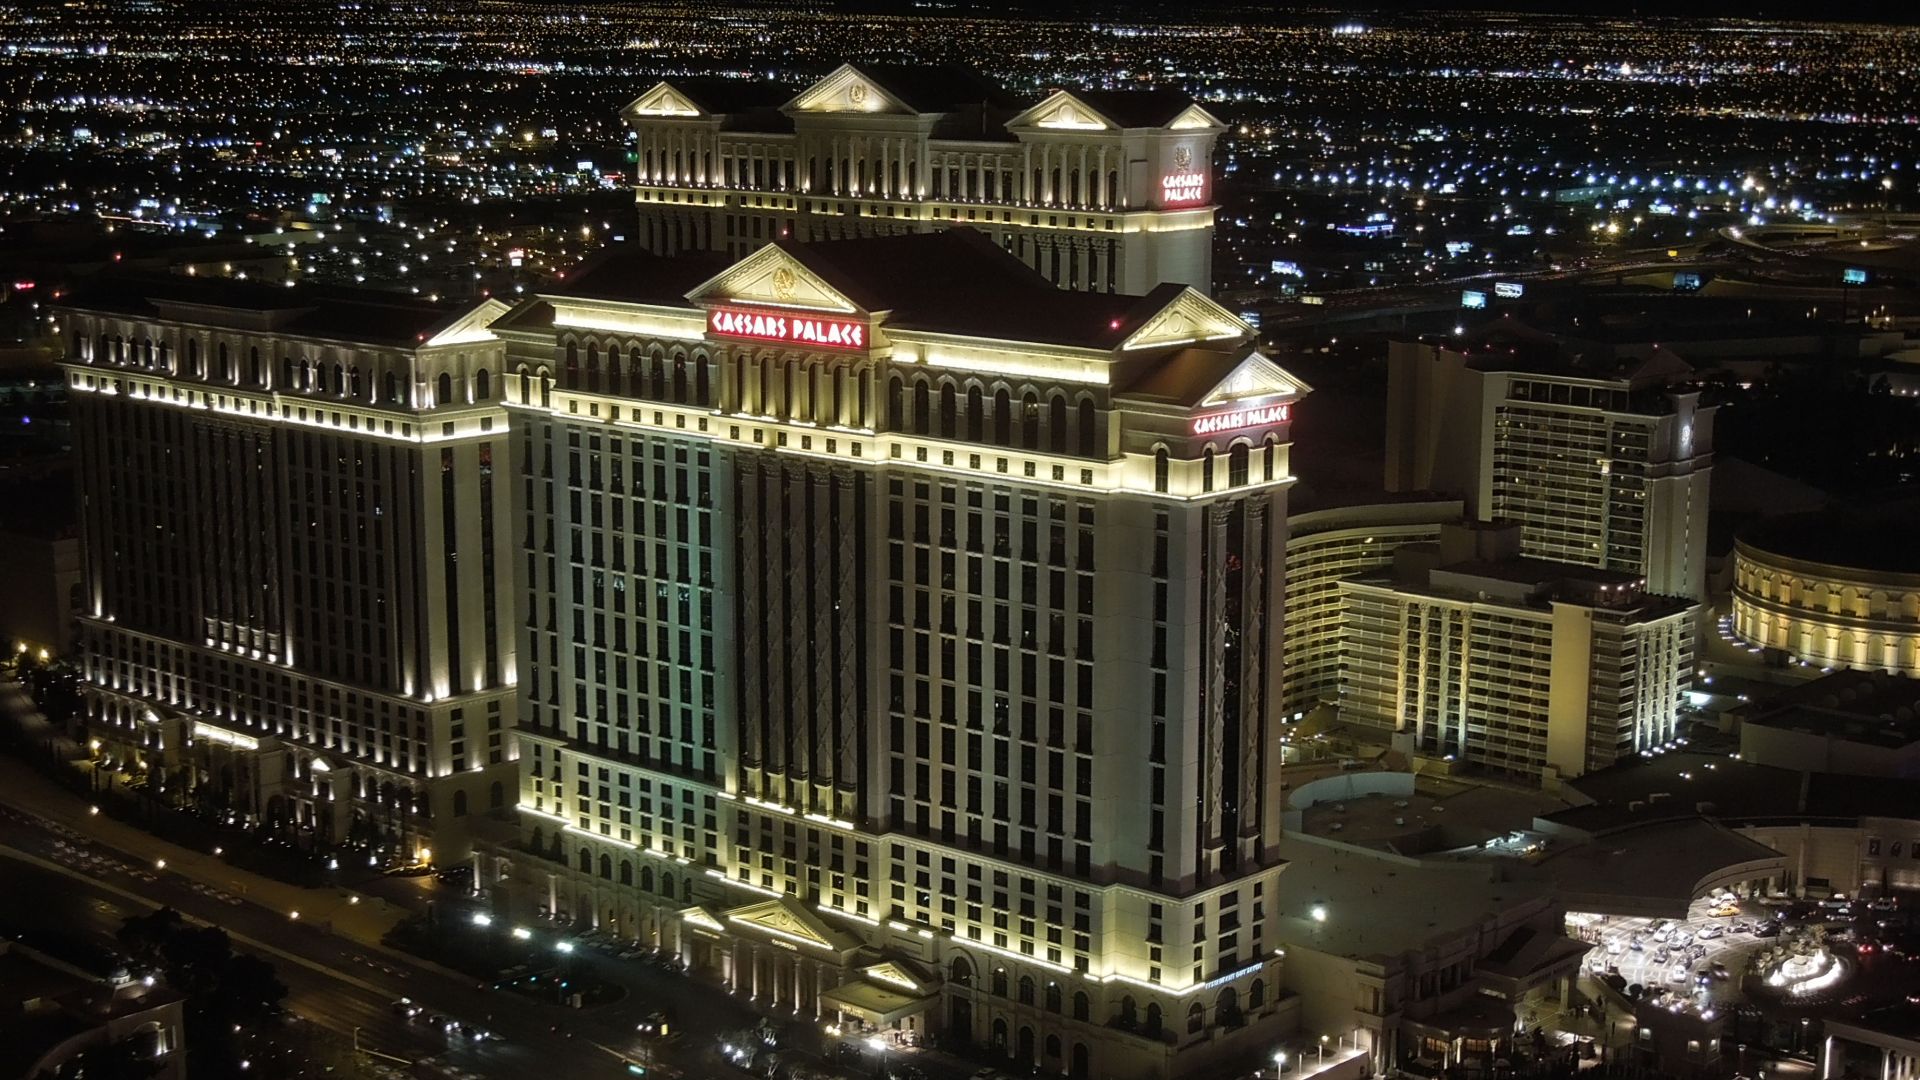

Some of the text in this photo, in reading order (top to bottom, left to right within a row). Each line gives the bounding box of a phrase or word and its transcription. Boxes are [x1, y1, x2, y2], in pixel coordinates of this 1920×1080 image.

[1163, 174, 1204, 188] CAESARS
[1165, 187, 1201, 201] PALACE
[712, 311, 862, 346] CAESARS PALACE
[1194, 405, 1288, 434] CAESARS PALACE
